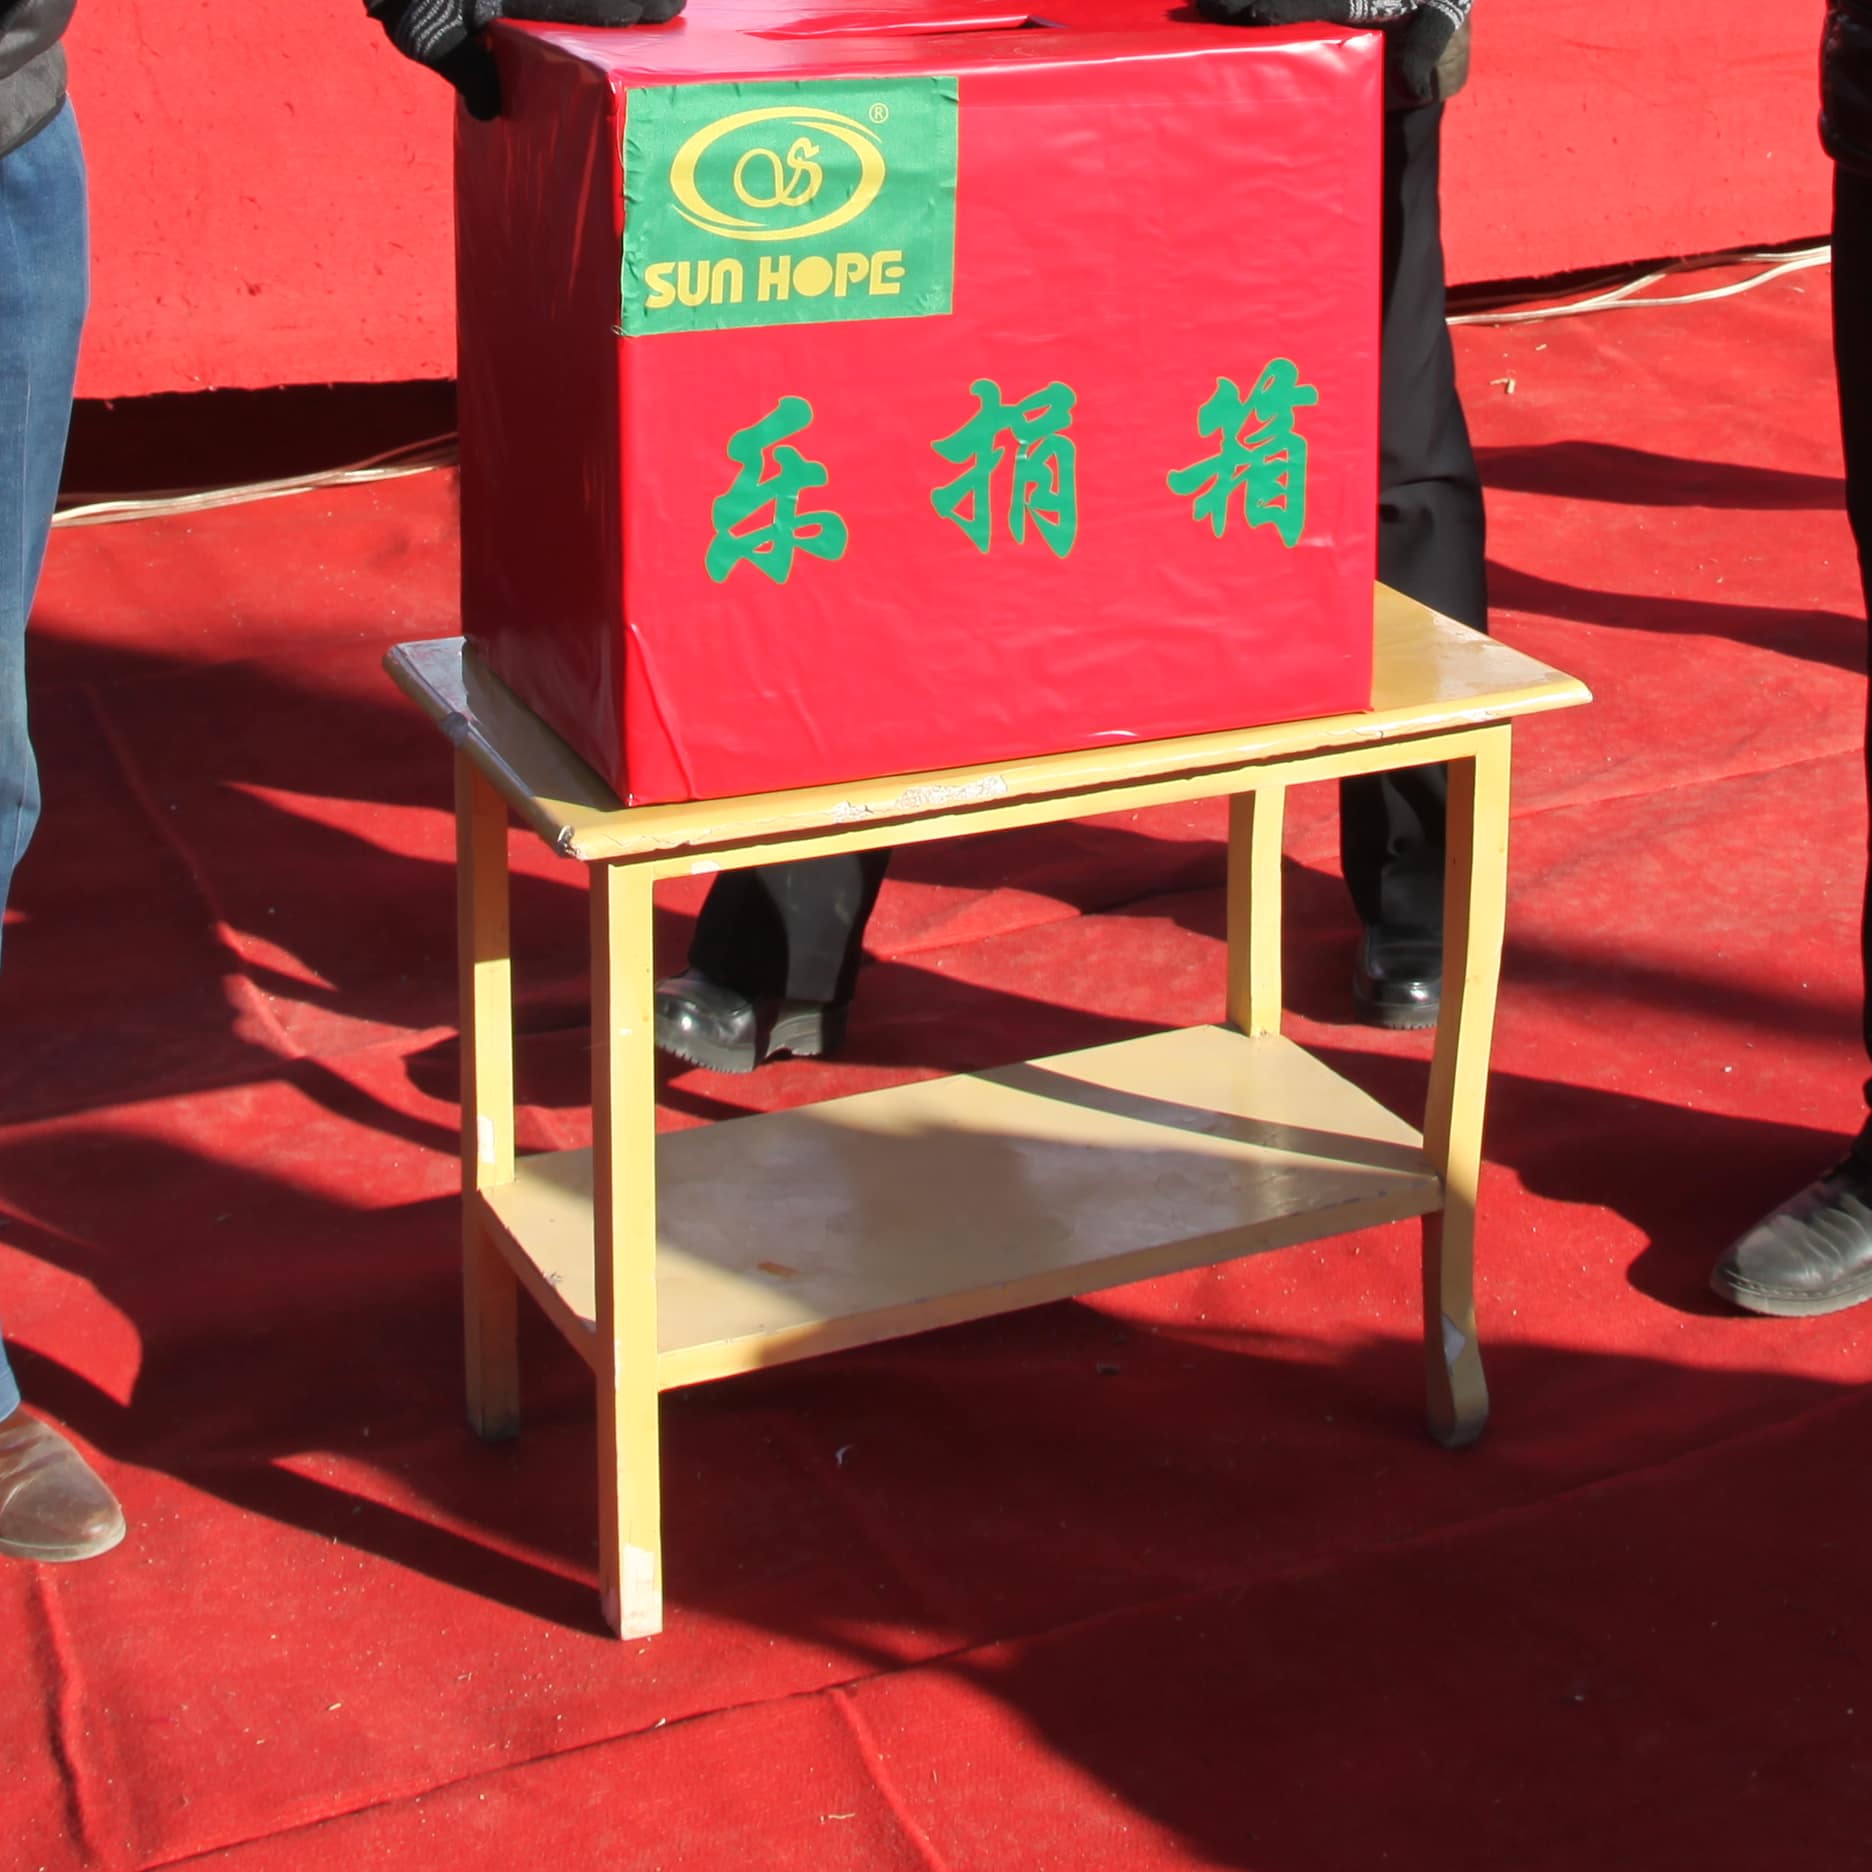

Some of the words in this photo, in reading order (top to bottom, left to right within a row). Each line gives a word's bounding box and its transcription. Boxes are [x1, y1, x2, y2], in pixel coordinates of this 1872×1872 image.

[643, 257, 744, 310] SUN
[757, 249, 907, 302] HOPE
[704, 357, 1320, 585] 乐捐箱
